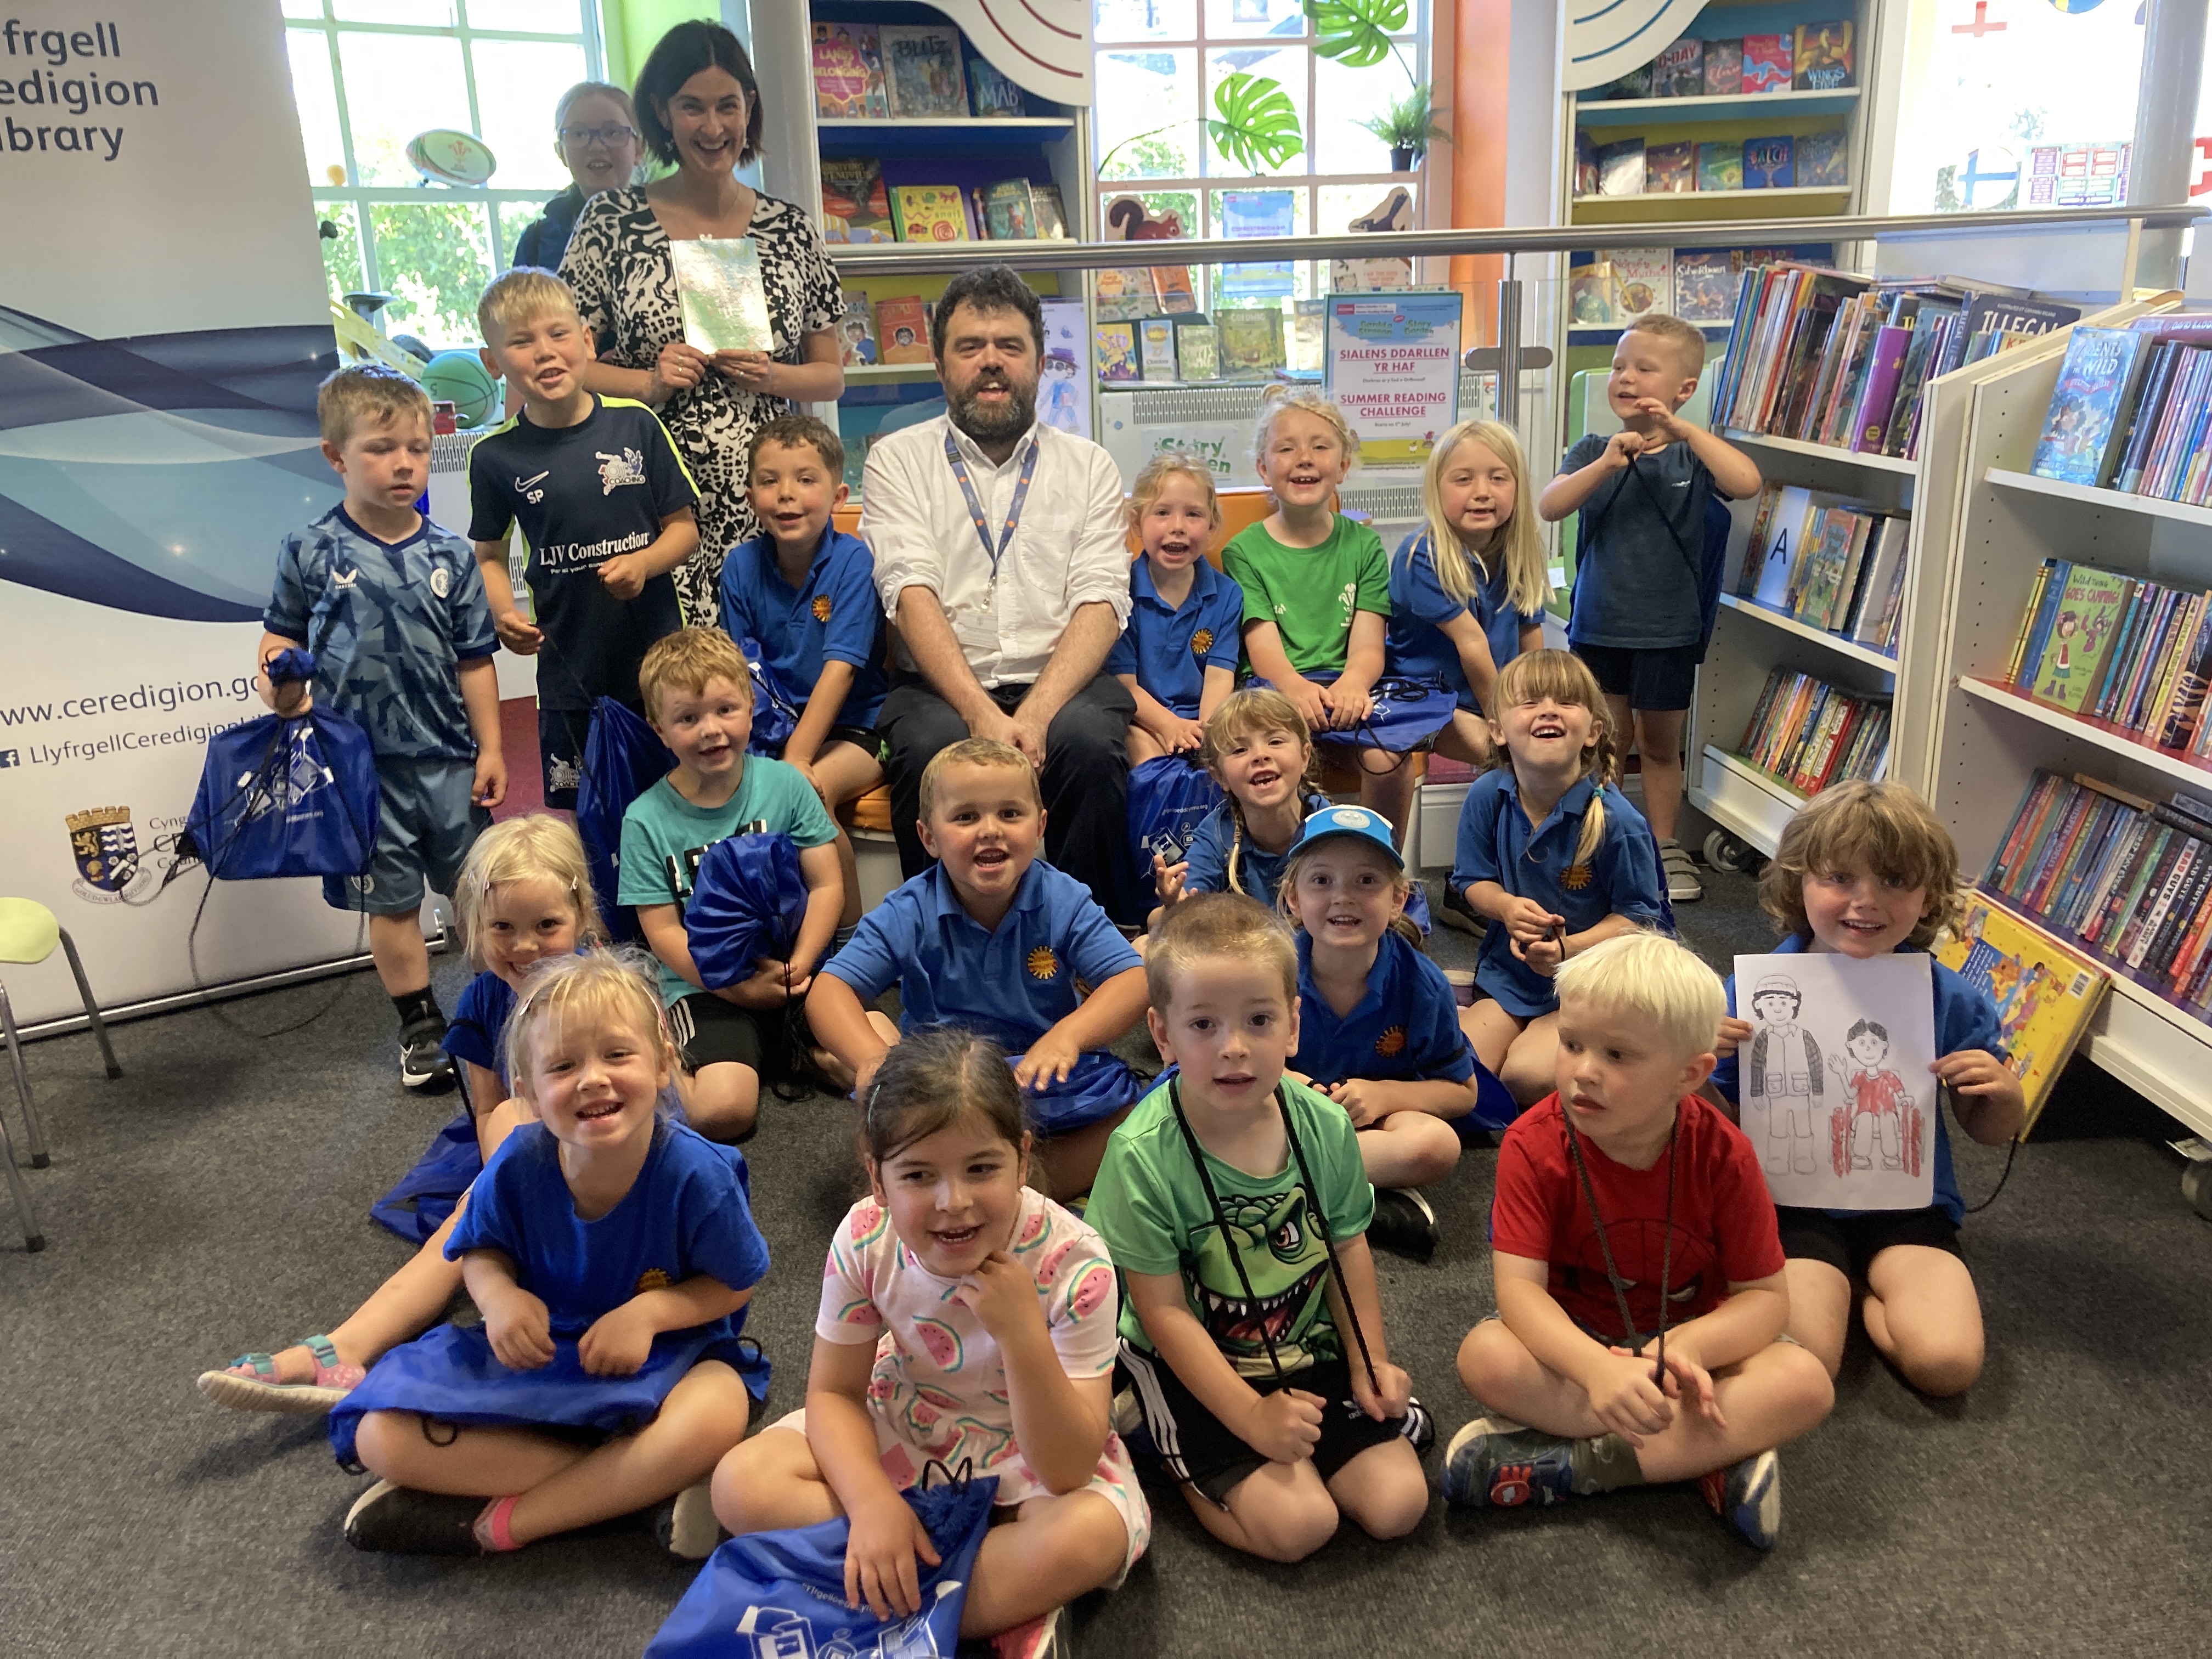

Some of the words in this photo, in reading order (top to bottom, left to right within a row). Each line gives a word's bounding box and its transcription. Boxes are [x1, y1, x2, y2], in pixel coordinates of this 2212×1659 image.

[2, 19, 121, 66] frgell
[1807, 66, 1846, 81] WINGS
[0, 69, 159, 115] edigion
[1340, 348, 1386, 359] SIALENS
[1391, 347, 1449, 358] DDARLLEN
[1373, 363, 1388, 372] YR
[1392, 362, 1415, 371] HAF
[2082, 358, 2119, 376] WILD
[1340, 394, 1390, 404] SUMMER
[1394, 392, 1446, 403] READING
[1360, 406, 1426, 417] CHALLENGE
[527, 489, 544, 504] SP
[539, 544, 565, 566] LJV
[568, 531, 650, 562] Construction
[1770, 527, 1787, 565] A
[2073, 574, 2092, 586] Wild
[2064, 586, 2086, 602] GOES
[2121, 853, 2135, 871] DAY
[2177, 851, 2192, 873] BAD
[2190, 859, 2203, 877] BAD
[2163, 873, 2181, 900] GUYS
[2177, 877, 2190, 900] GUYS
[2189, 884, 2204, 906] GUYS
